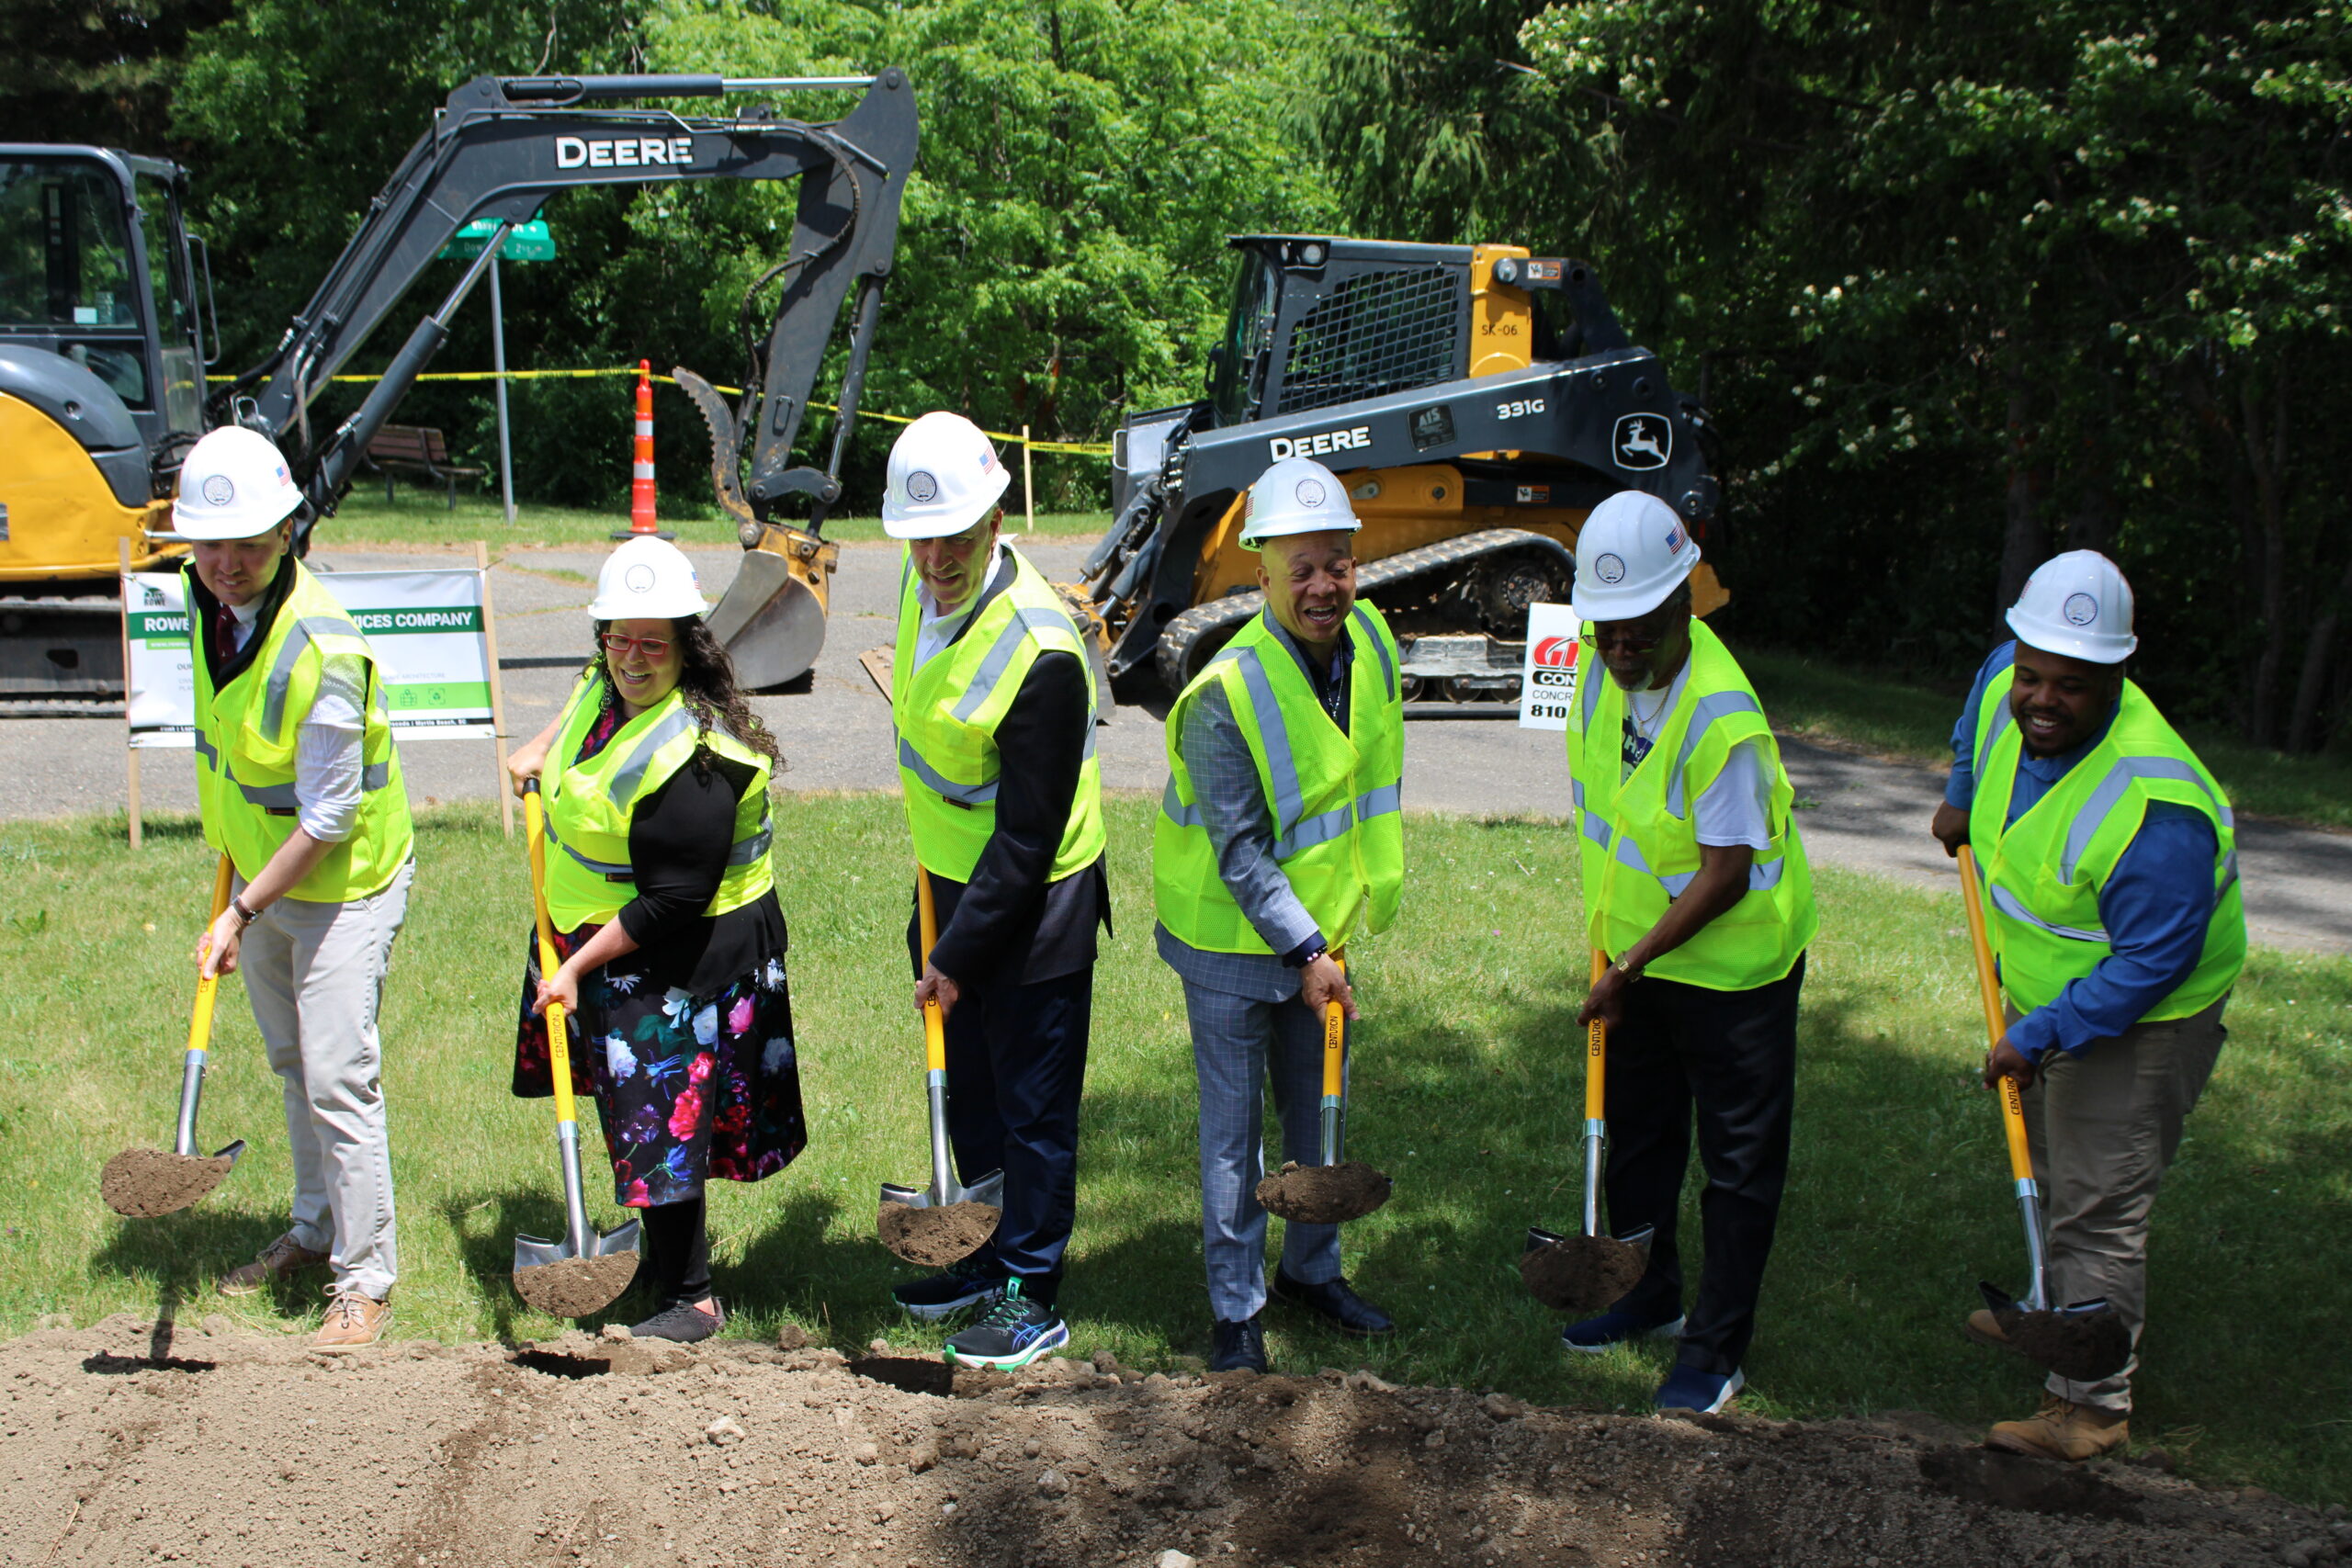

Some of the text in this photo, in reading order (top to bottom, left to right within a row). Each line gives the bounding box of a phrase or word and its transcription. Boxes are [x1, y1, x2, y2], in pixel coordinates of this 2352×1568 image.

[556, 137, 694, 169] DEERE
[1481, 324, 1518, 336] SK-06
[1497, 399, 1545, 420] 331G
[1270, 426, 1371, 463] DEERE
[144, 596, 166, 606] ROWE
[144, 617, 189, 631] ROWE
[395, 612, 472, 628] COMPANY
[1531, 705, 1566, 718] 810
[552, 1013, 565, 1059] CENTURION
